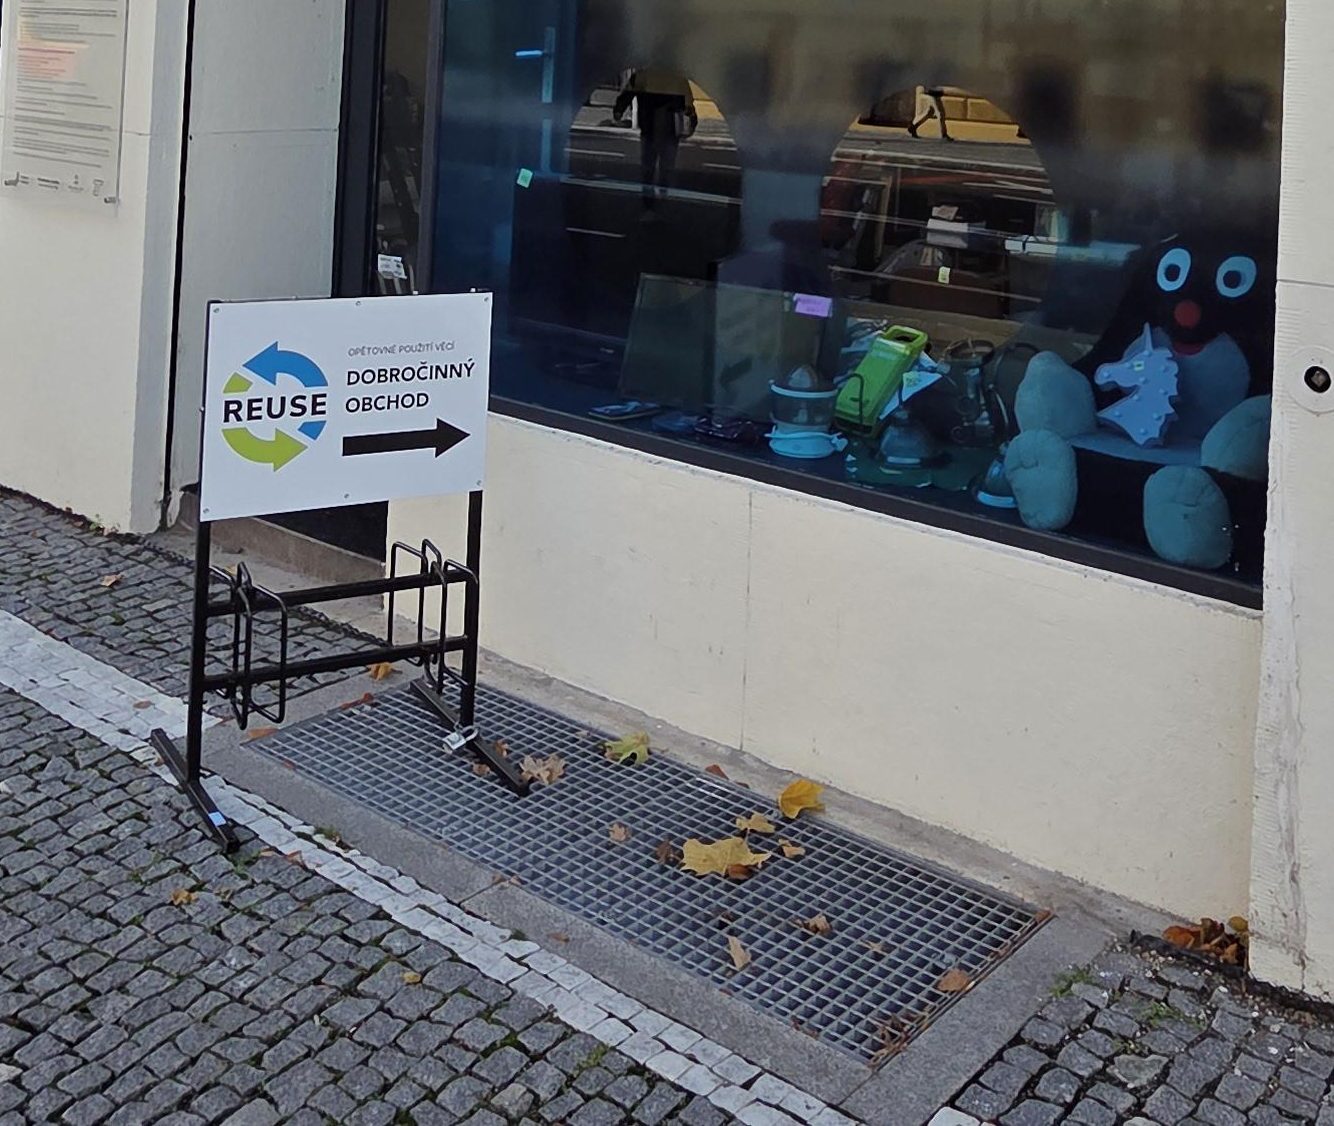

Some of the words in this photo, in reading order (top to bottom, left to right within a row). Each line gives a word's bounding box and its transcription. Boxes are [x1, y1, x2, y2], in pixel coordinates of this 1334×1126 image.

[346, 357, 475, 386] DOBROČINNÝ
[223, 393, 328, 423] REUSE
[345, 392, 429, 413] OBCHOD
